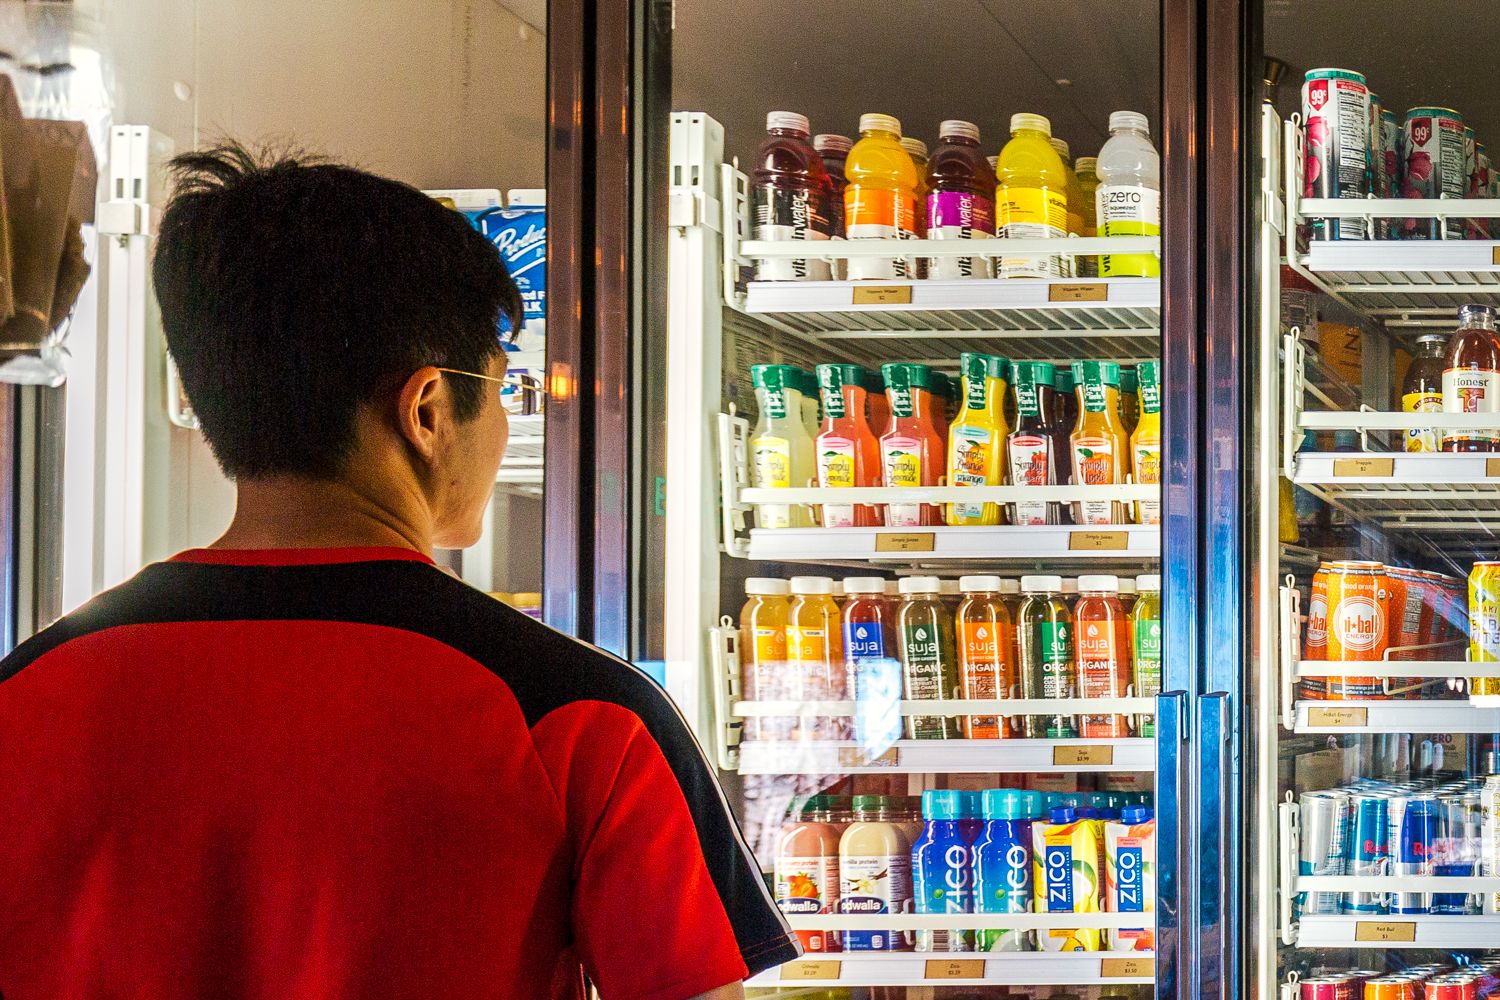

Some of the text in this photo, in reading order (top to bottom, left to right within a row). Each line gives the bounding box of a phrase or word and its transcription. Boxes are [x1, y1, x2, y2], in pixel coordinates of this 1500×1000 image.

[1109, 190, 1141, 204] zero
[1453, 377, 1489, 388] Honest
[957, 446, 984, 463] Simply
[1015, 457, 1042, 473] Simply
[956, 475, 984, 486] mango
[850, 640, 879, 655] suja
[908, 641, 937, 655] suja
[969, 641, 998, 654] suja
[1080, 638, 1109, 651] suja
[1048, 851, 1067, 903] ZICO
[1119, 852, 1137, 904] ZICO
